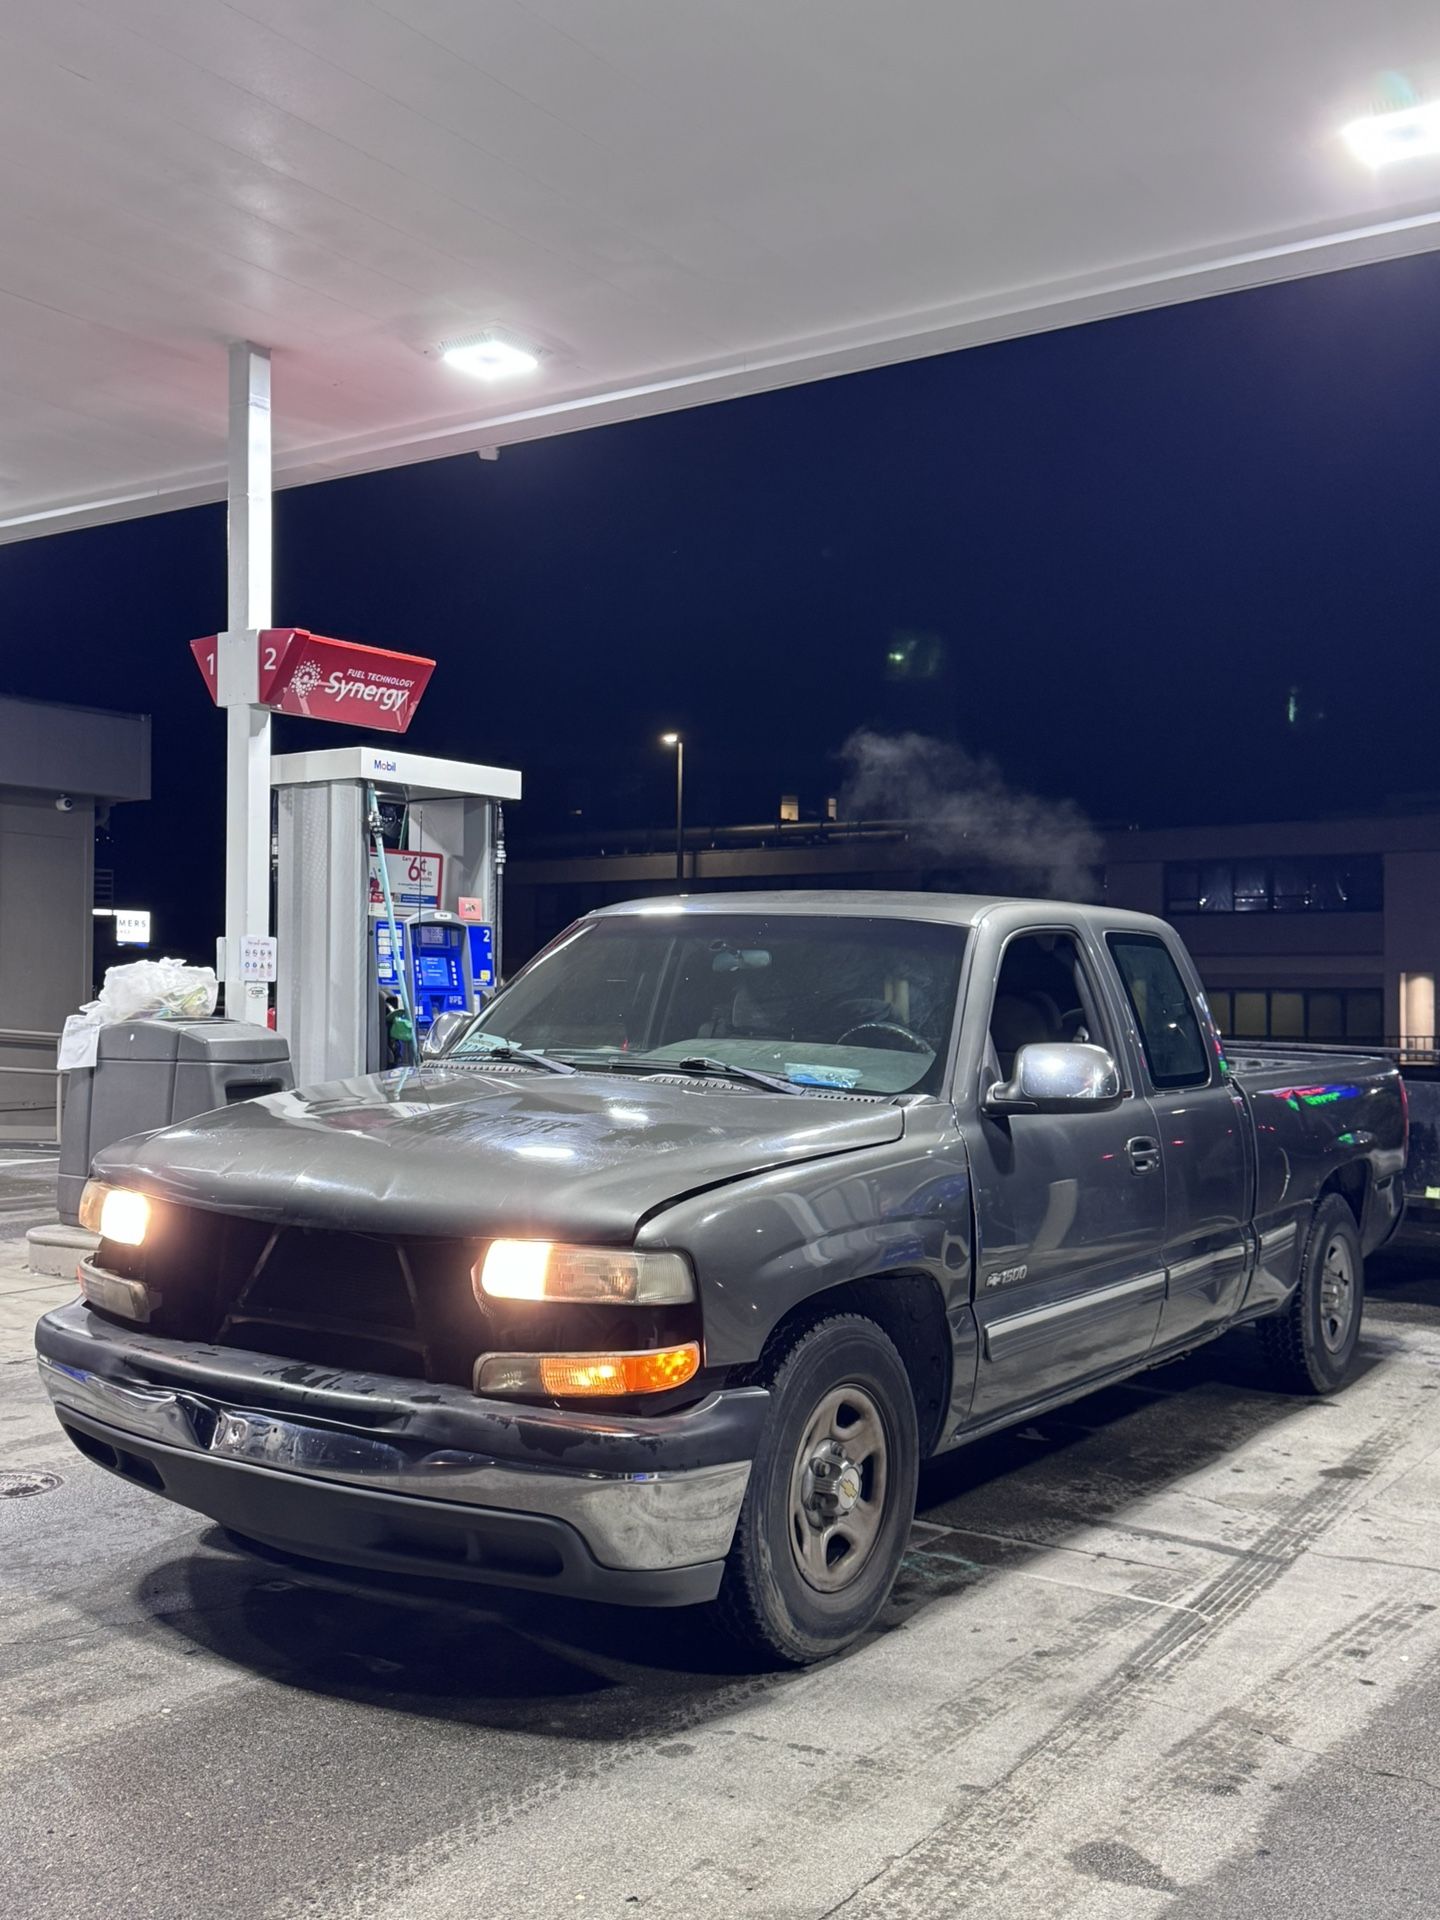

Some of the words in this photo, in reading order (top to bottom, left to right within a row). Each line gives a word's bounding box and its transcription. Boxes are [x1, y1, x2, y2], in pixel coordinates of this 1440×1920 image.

[206, 652, 215, 676] 1
[264, 647, 277, 670] 2
[346, 668, 365, 679] FUEL
[367, 672, 415, 687] TECHNOLOGY
[324, 671, 410, 711] Synergy
[374, 759, 396, 771] Mobil
[483, 929, 490, 942] 2
[1002, 1265, 1027, 1284] 1500
